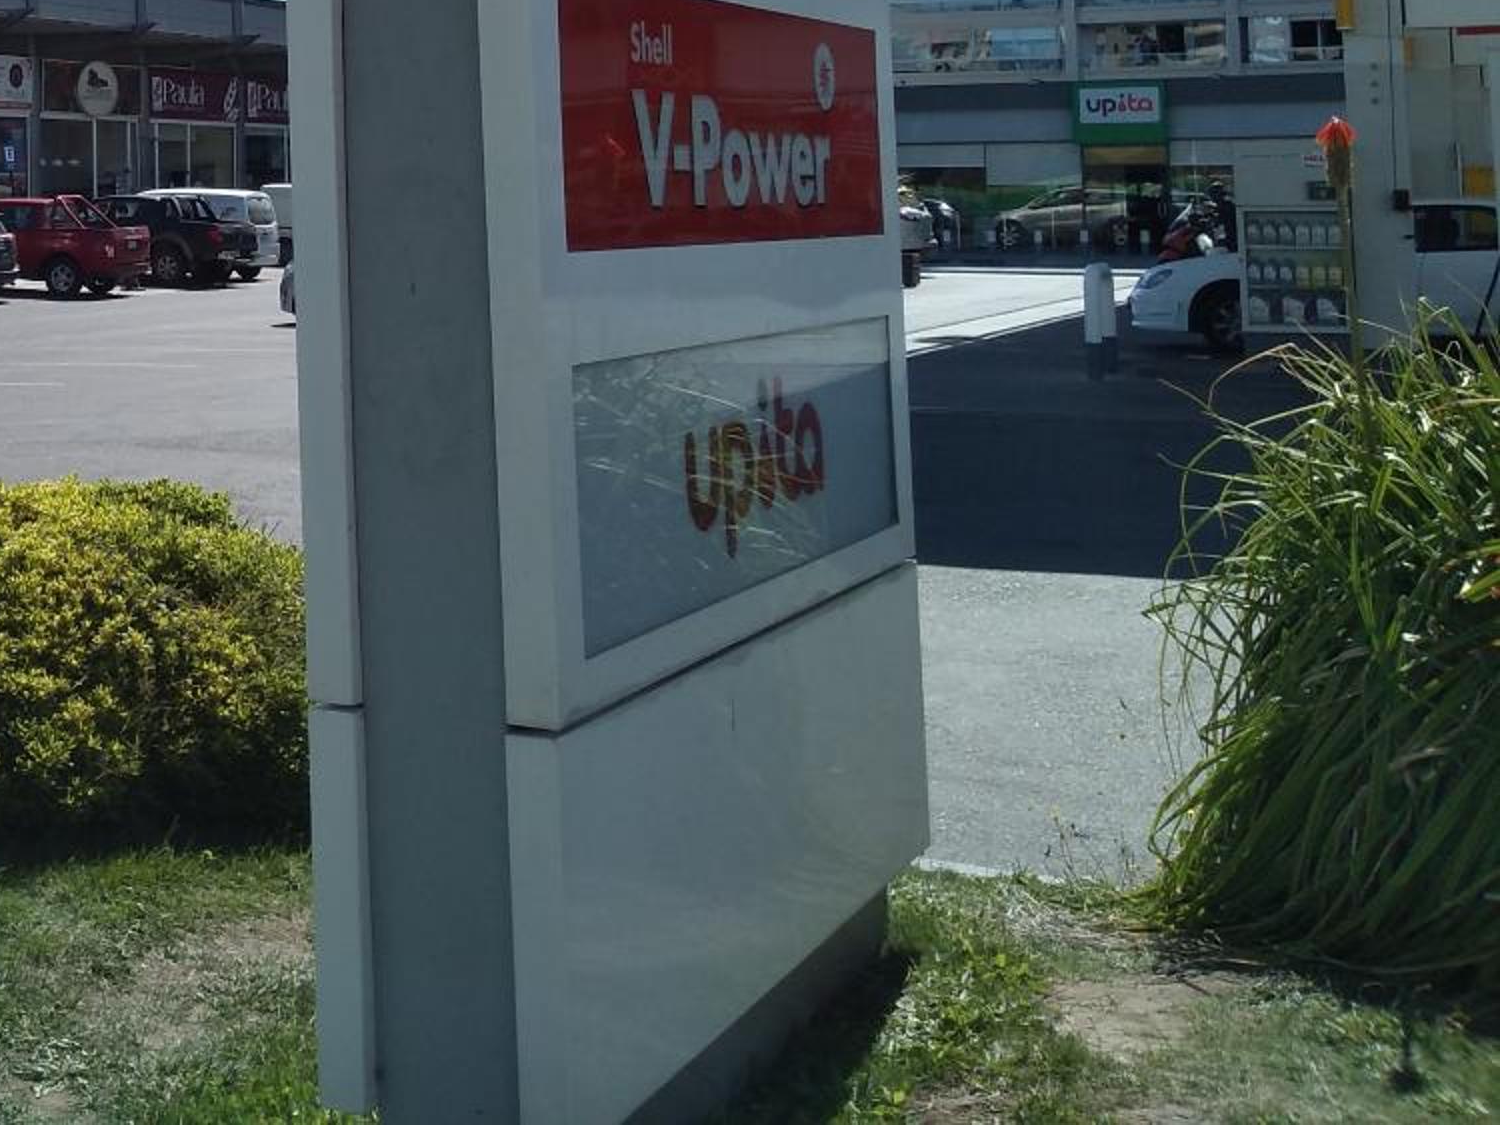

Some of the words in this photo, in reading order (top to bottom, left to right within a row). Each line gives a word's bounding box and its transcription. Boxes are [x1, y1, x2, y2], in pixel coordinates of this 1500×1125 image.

[630, 20, 673, 66] Shell
[1085, 92, 1155, 118] upita
[631, 89, 832, 208] V-Power
[684, 375, 826, 561] upita
